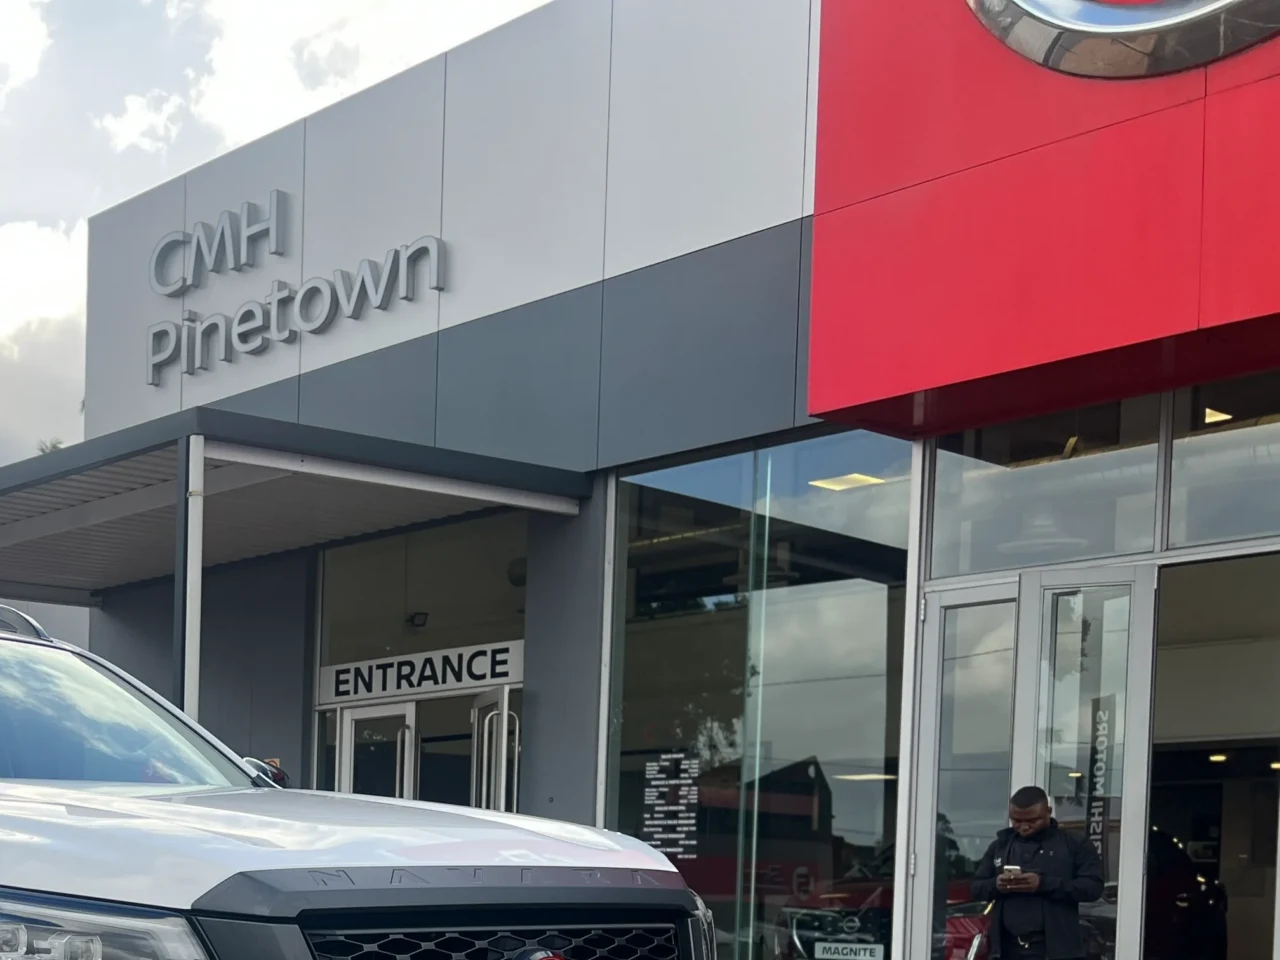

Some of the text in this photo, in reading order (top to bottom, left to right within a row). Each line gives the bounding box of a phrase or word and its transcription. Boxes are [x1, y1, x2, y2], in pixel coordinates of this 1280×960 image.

[149, 188, 289, 297] CMH
[146, 234, 447, 386] Pinetown
[334, 647, 510, 697] ENTRANCE
[822, 946, 877, 958] MAGNITE
